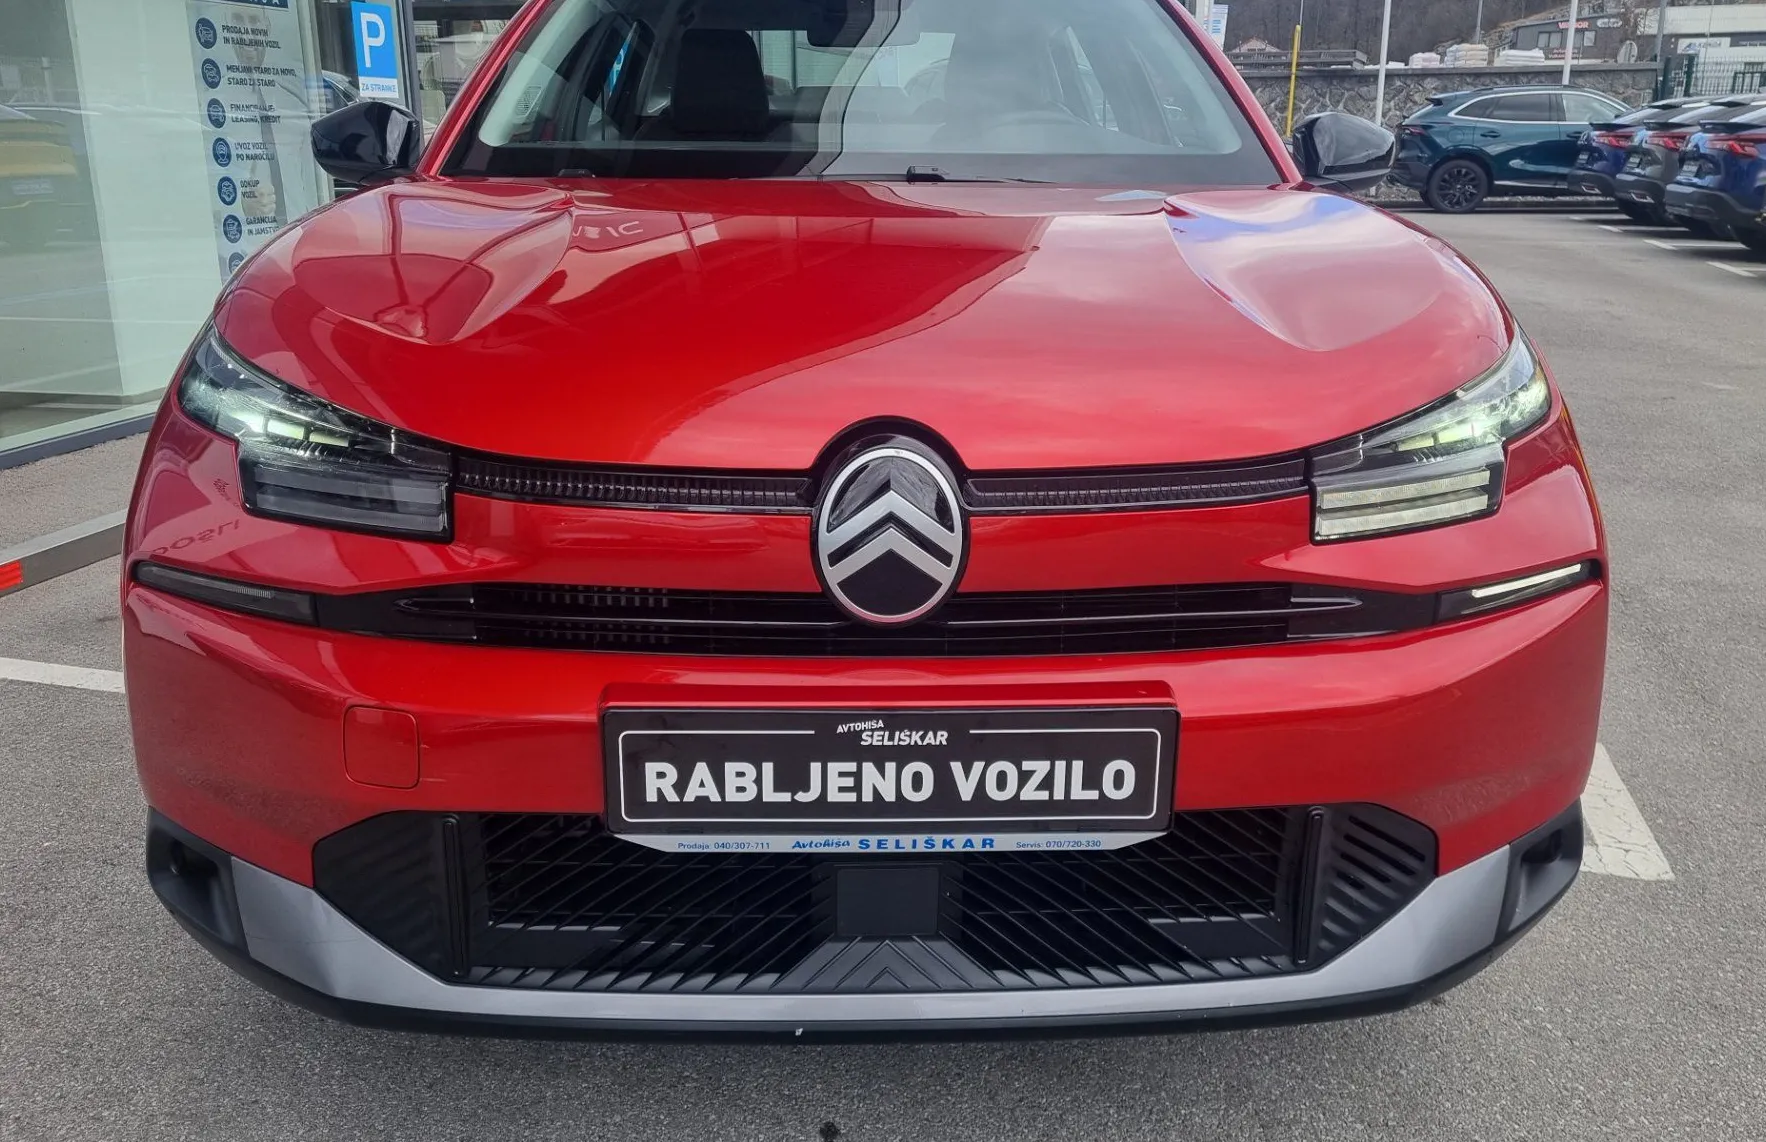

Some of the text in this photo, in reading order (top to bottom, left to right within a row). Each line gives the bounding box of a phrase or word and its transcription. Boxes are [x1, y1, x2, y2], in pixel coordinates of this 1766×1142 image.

[222, 25, 249, 35] PRODAJA
[223, 36, 231, 45] IN
[360, 12, 385, 68] P
[228, 77, 248, 86] STARO
[257, 79, 276, 87] STARO
[361, 83, 397, 92] ZA STRANKE
[240, 180, 260, 189] ODKUP
[860, 730, 948, 745] SELIŠKAR
[644, 759, 1136, 803] RABLJENO VOZILO
[713, 841, 770, 851] 040/307-711
[1045, 839, 1102, 849] 070/720-330
